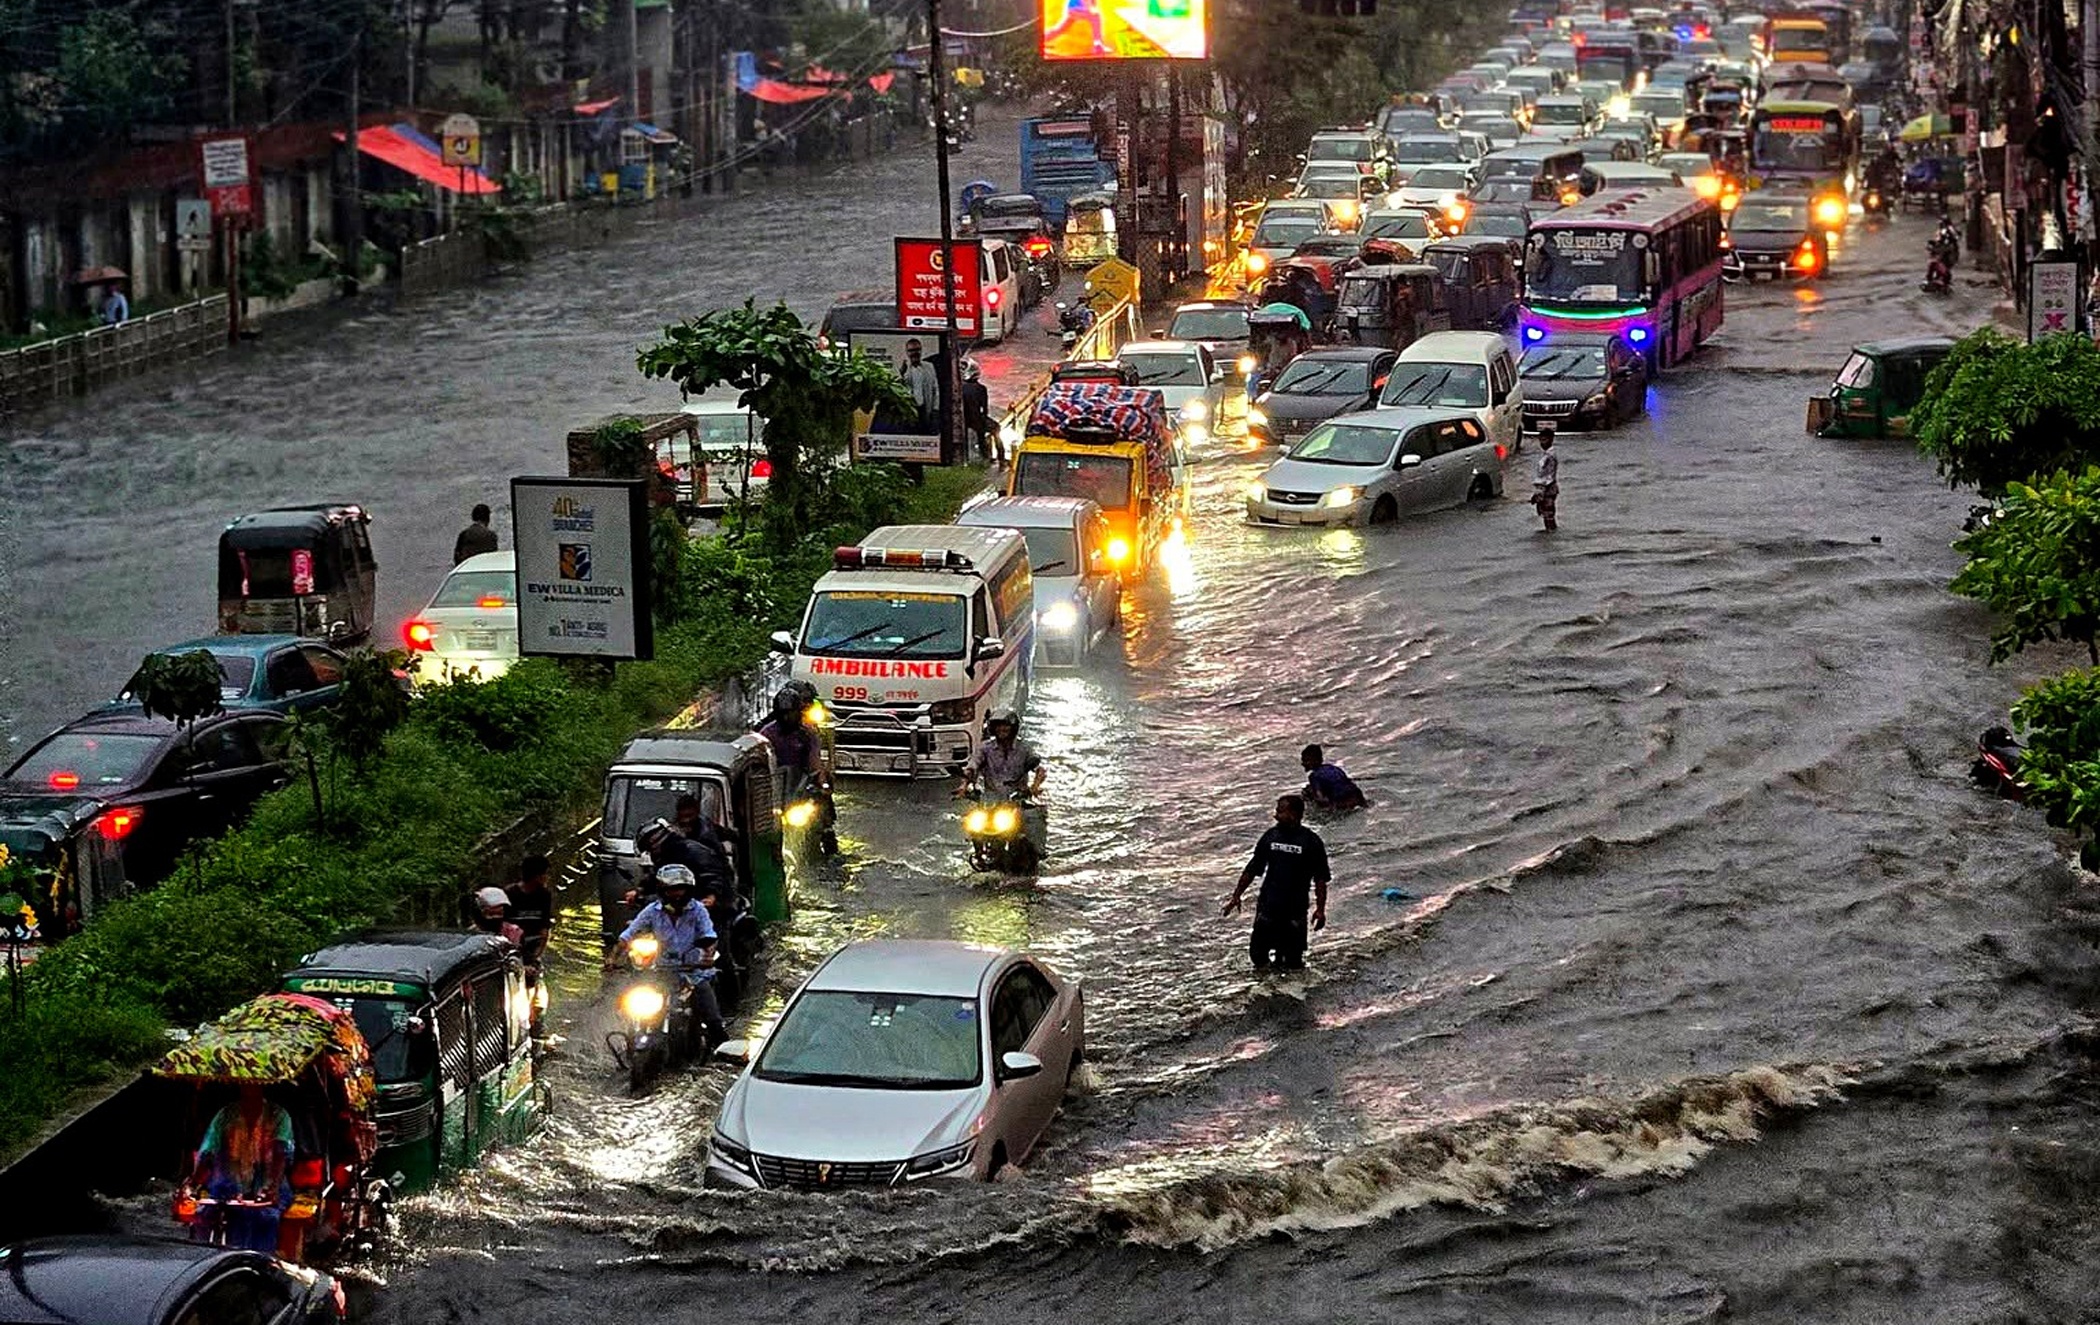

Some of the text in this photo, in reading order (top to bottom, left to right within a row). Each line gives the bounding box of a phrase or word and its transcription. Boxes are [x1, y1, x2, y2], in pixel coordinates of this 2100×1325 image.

[551, 584, 582, 596] VILLA
[583, 585, 625, 598] MEDICA
[810, 658, 949, 679] AMBULANCE
[833, 686, 868, 700] 999
